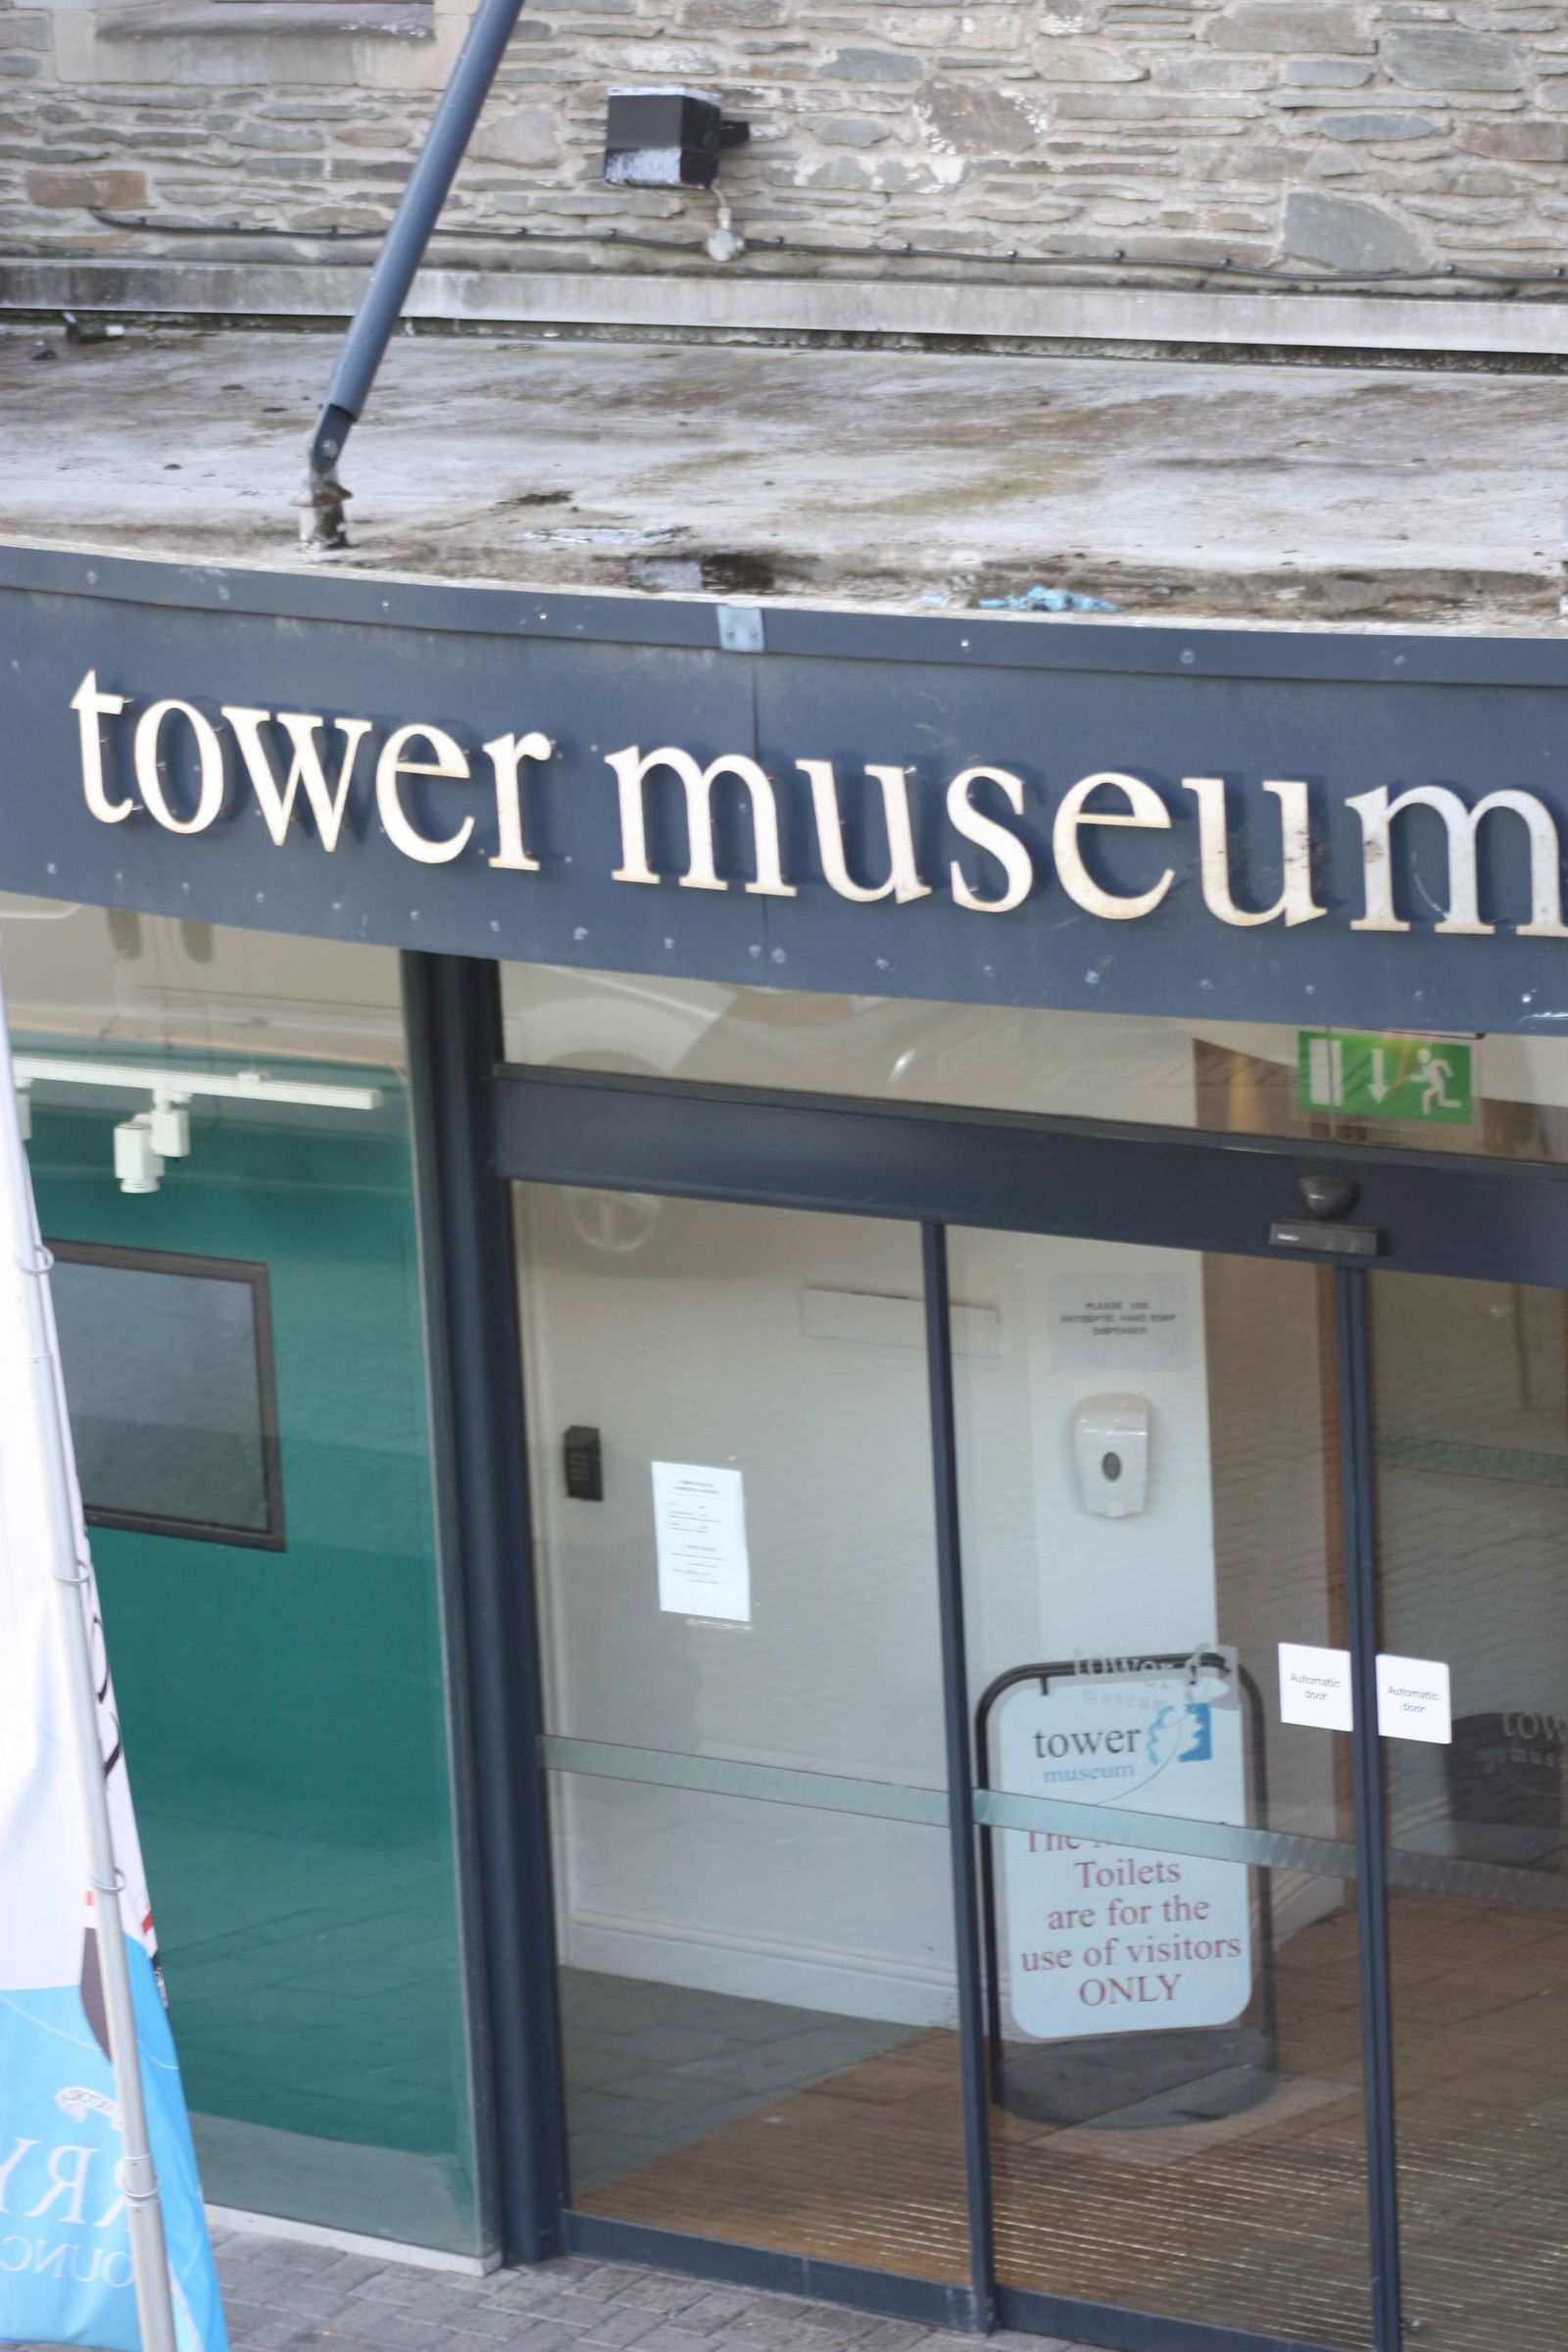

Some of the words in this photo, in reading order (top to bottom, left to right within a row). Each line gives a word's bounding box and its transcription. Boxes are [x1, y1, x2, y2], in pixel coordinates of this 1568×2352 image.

[70, 668, 553, 871] tower
[604, 744, 1568, 938] museum
[1289, 1672, 1342, 1689] Automatic
[1387, 1686, 1440, 1701] Automatic
[1033, 1729, 1142, 1759] tower
[1042, 1764, 1136, 1784] museum
[1073, 1858, 1182, 1888] Toilets
[1048, 1907, 1096, 1931] are
[1106, 1897, 1152, 1927] for
[1162, 1894, 1210, 1923] the
[1019, 1948, 1073, 1972] use
[1082, 1936, 1120, 1967] of
[1125, 1934, 1242, 1963] visitors
[1079, 1973, 1183, 2007] ONLY
